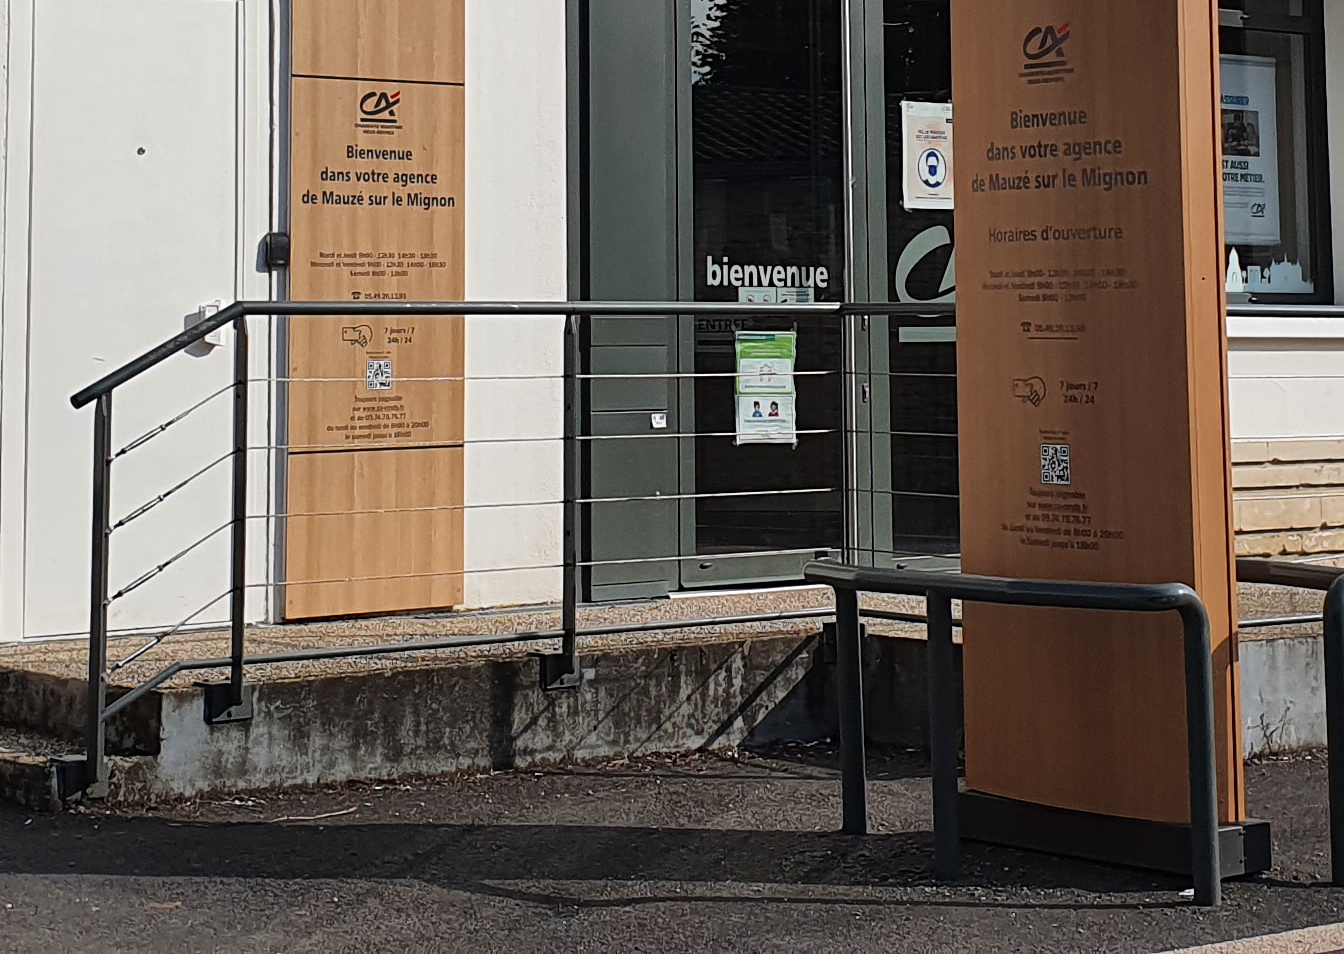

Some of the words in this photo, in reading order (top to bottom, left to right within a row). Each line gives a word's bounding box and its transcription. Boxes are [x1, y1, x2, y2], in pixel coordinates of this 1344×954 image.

[1010, 108, 1087, 130] Bienvenue
[346, 144, 413, 161] Bienvenue
[986, 142, 1016, 161] dans
[1019, 141, 1059, 159] votre
[1063, 137, 1123, 161] agence
[320, 167, 351, 182] dans
[355, 168, 389, 183] votre
[393, 171, 438, 187] agence
[971, 173, 986, 193] de
[989, 169, 1031, 192] Mauzé
[1035, 174, 1057, 190] sur
[1062, 168, 1077, 188] le
[1081, 167, 1149, 192] Mignon
[301, 189, 318, 204] de
[322, 190, 364, 206] Mauzé
[368, 193, 388, 206] sur
[392, 192, 403, 206] le
[407, 192, 455, 210] Mignon
[988, 226, 1037, 243] Horaires
[1040, 224, 1123, 241] d'ouverture
[706, 256, 829, 289] bienvenue
